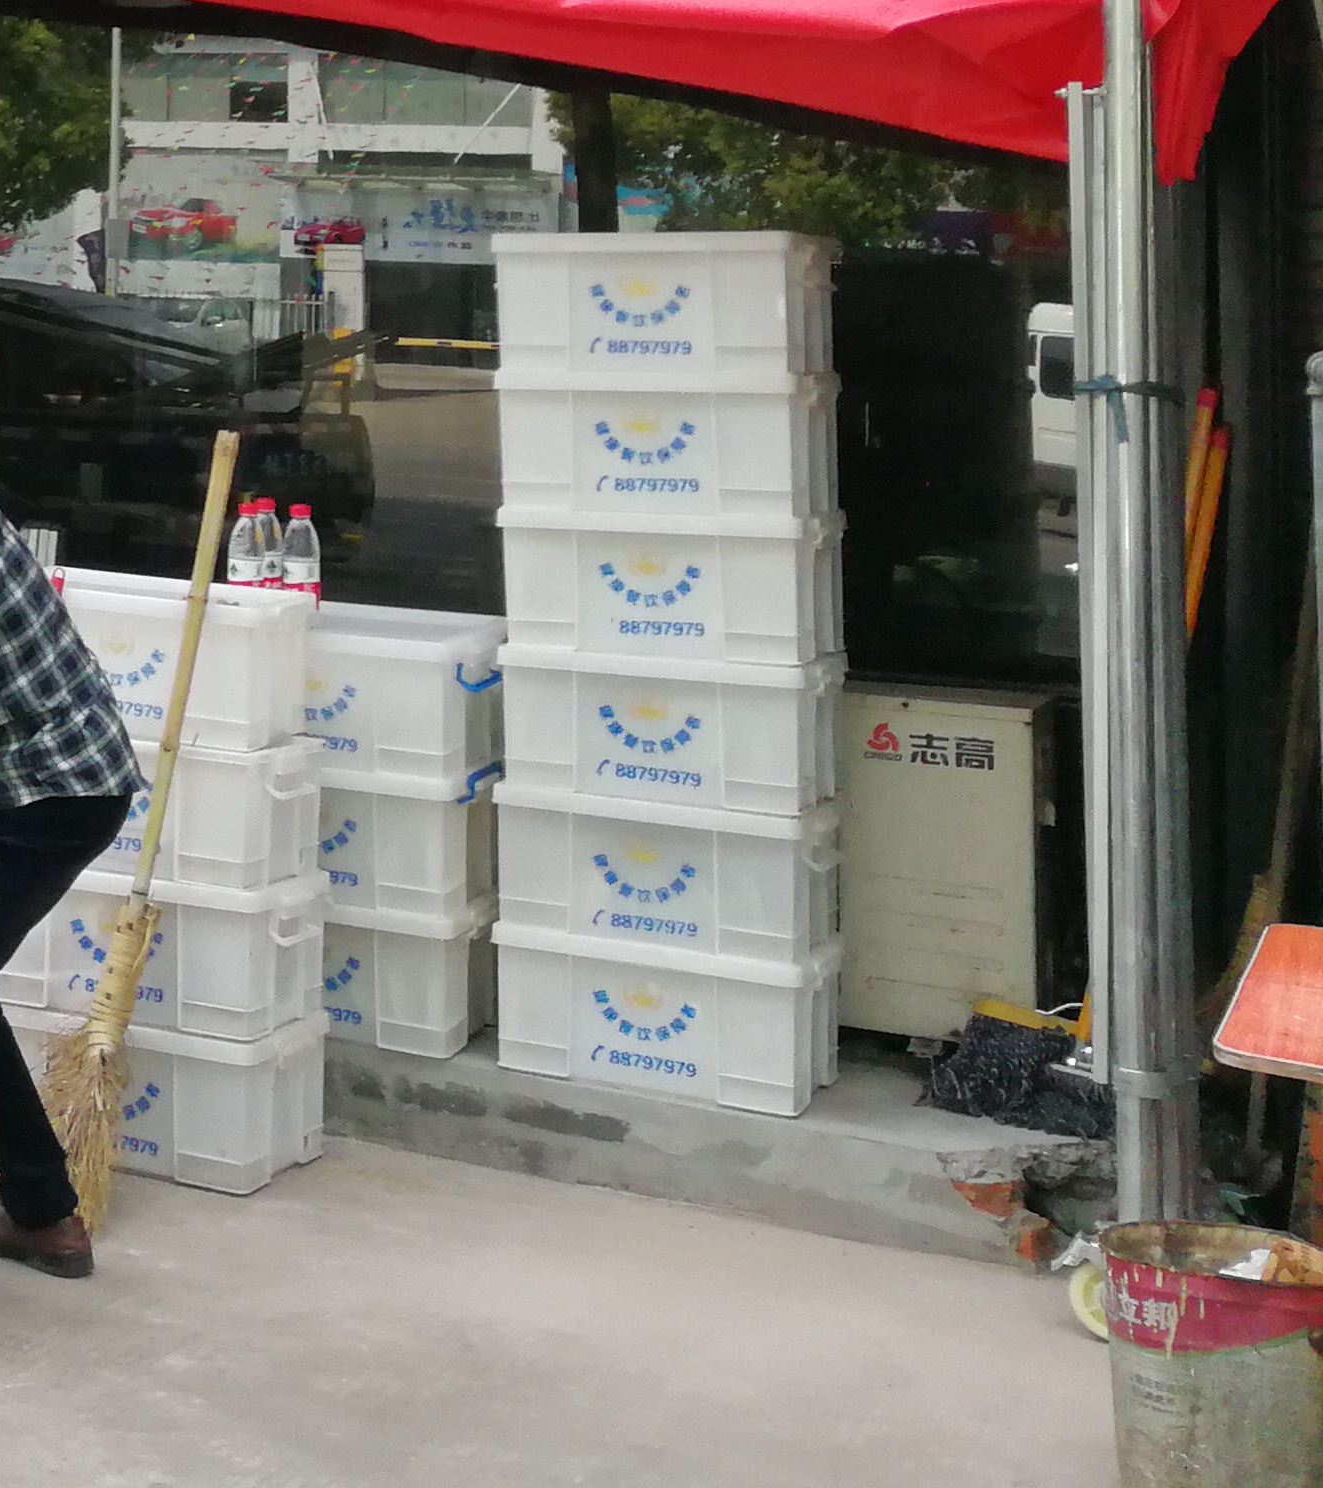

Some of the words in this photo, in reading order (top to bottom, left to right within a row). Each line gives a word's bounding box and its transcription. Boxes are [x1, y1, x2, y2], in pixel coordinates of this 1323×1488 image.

[615, 477, 700, 492] 88797979
[619, 620, 705, 637] 88797979
[909, 733, 994, 771] 志高
[615, 762, 702, 787] 88797979
[610, 913, 698, 937] 88797979
[609, 1050, 697, 1078] 88797979
